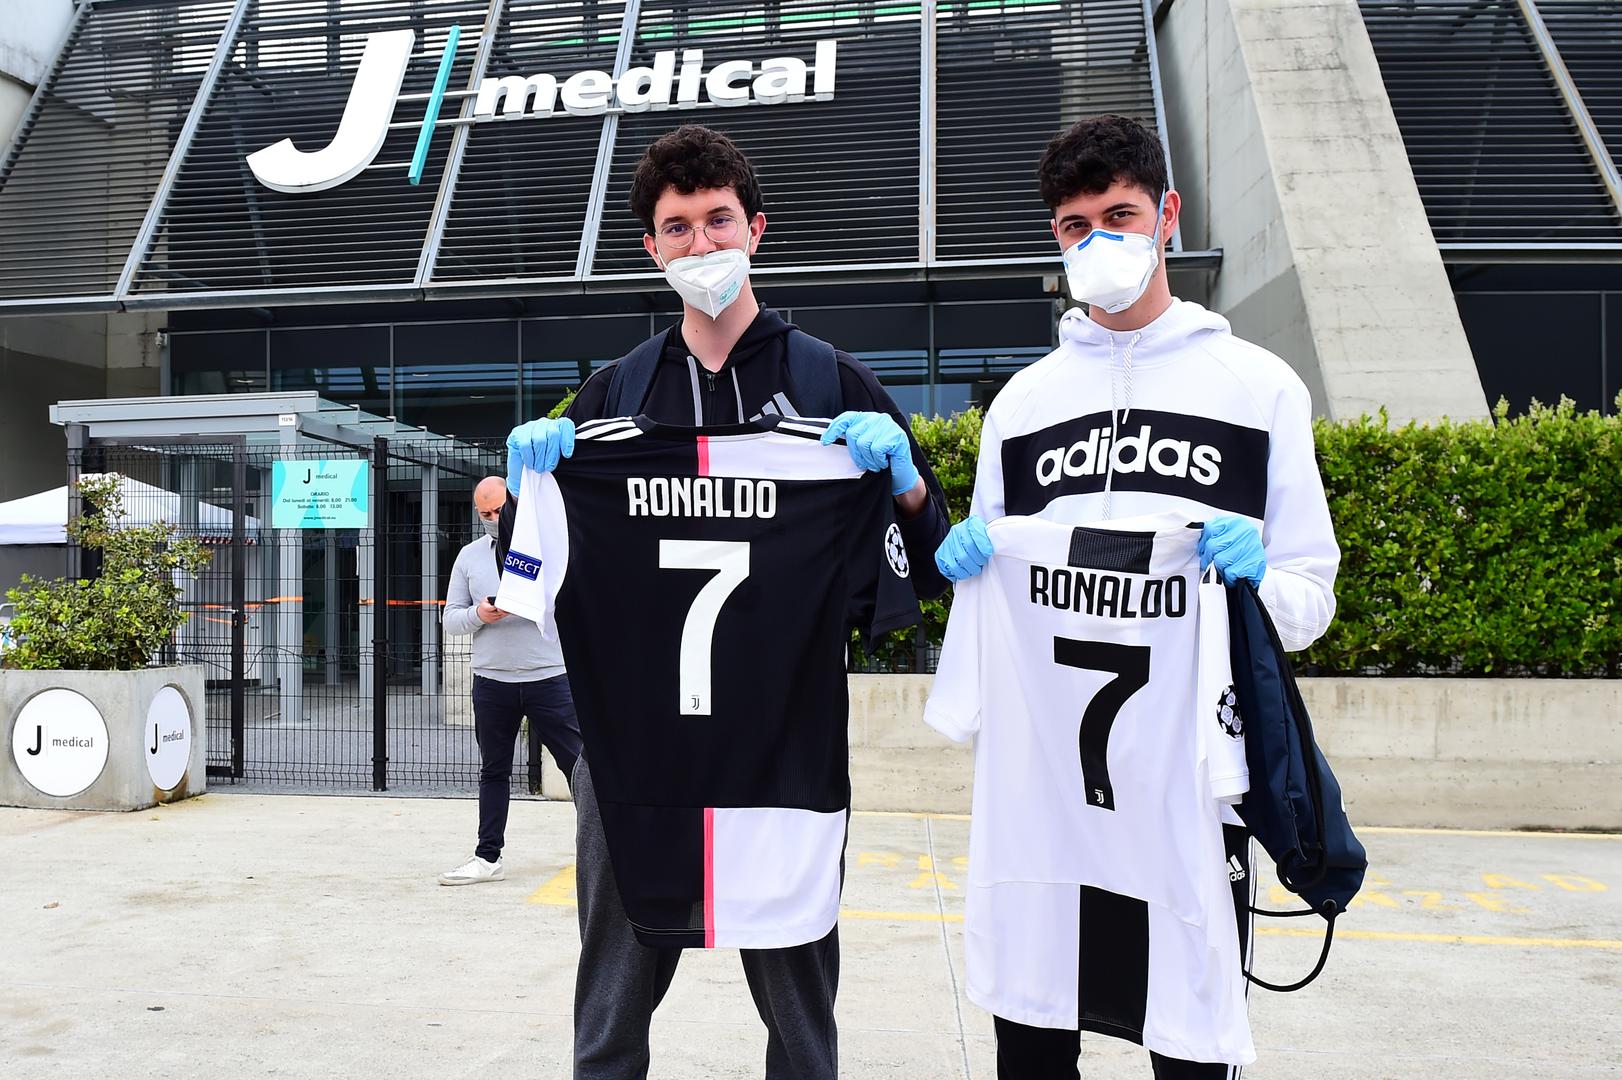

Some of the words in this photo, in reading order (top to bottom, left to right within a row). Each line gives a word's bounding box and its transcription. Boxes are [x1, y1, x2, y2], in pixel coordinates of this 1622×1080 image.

[245, 29, 416, 194] J
[473, 40, 837, 123] medical
[302, 468, 311, 484] J
[1035, 425, 1222, 487] adidas
[627, 477, 777, 519] RONALDO
[504, 553, 541, 576] SPECT
[1030, 565, 1187, 619] RONALDO
[659, 539, 751, 716] 7
[26, 725, 42, 756] J
[52, 736, 94, 748] medical
[150, 722, 159, 755] J
[162, 729, 185, 744] medical
[1053, 635, 1152, 812] 7
